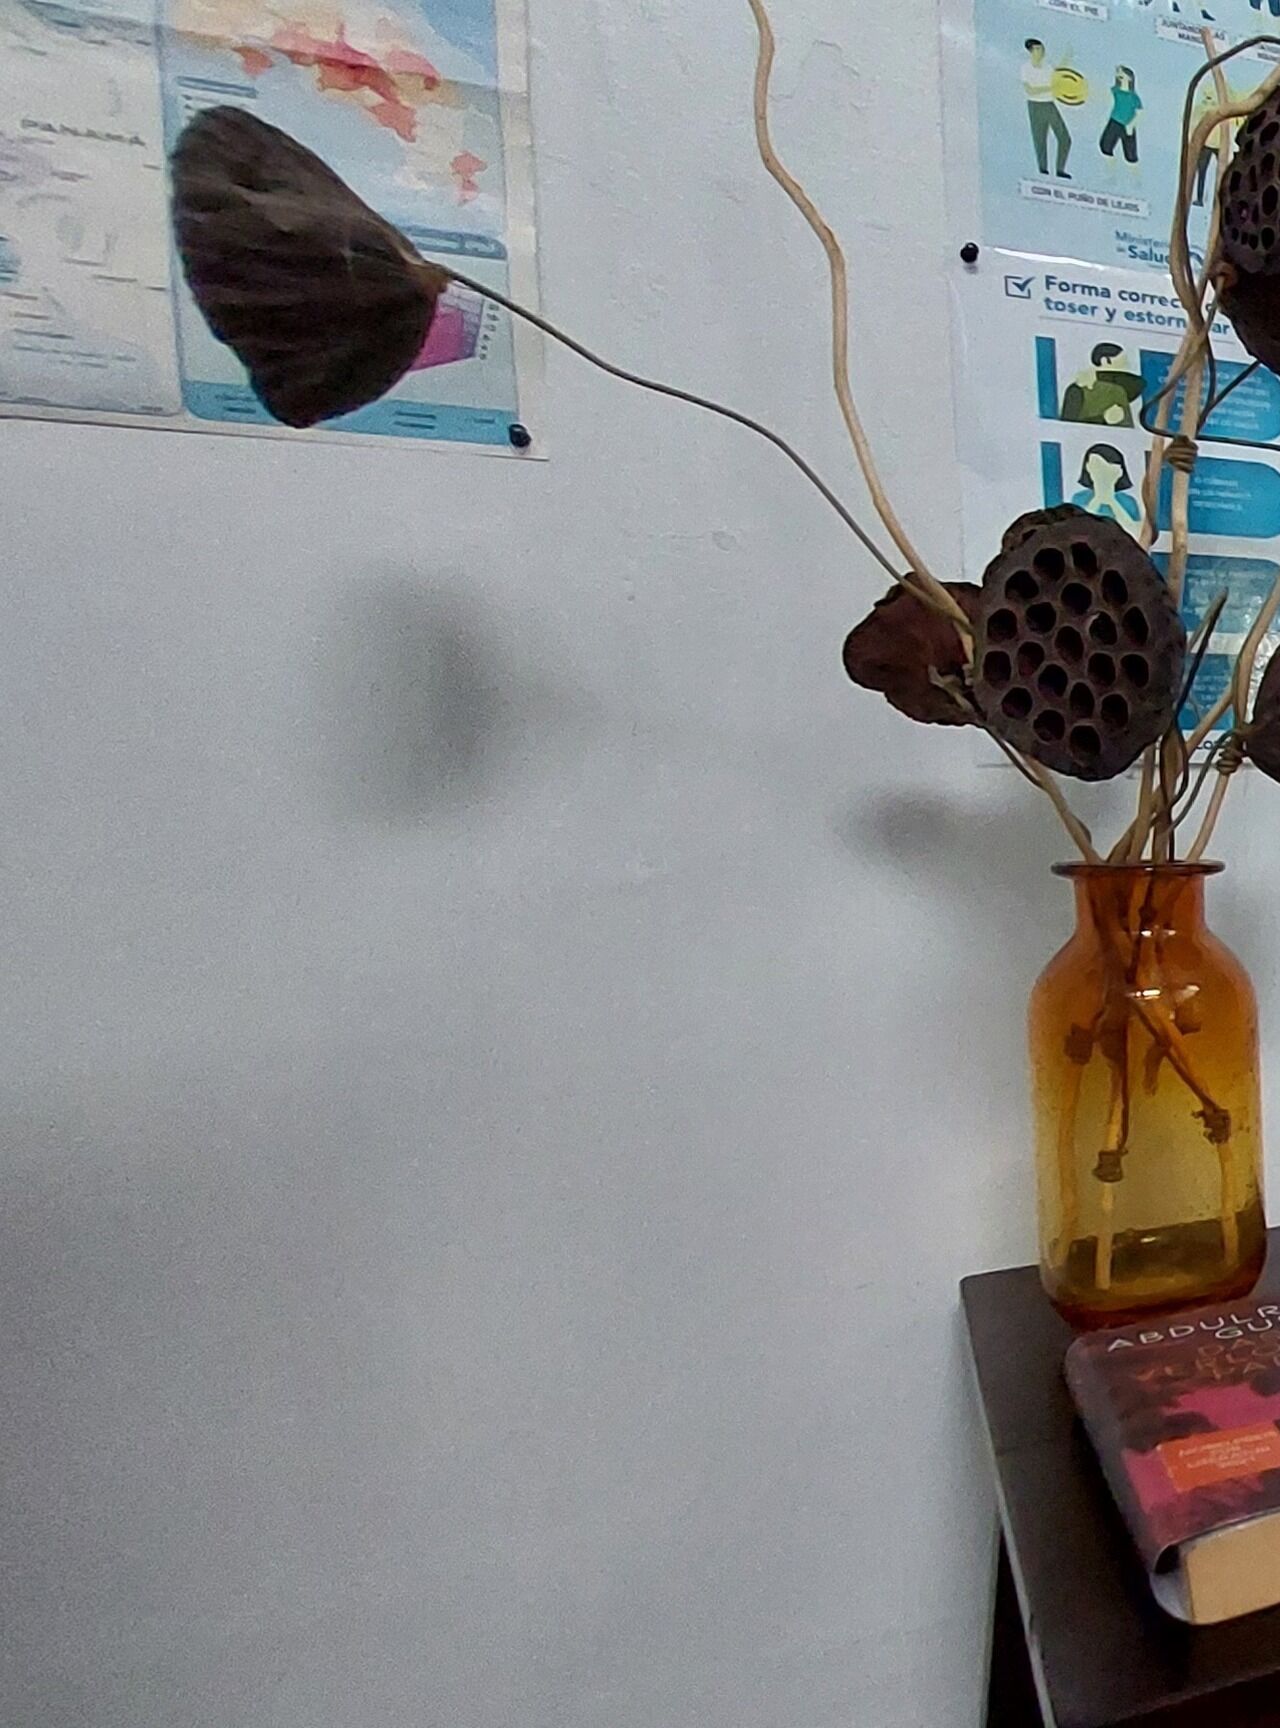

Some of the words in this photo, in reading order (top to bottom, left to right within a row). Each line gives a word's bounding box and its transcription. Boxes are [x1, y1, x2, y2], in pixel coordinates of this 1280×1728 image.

[1053, 188, 1065, 199] EL
[1128, 245, 1170, 264] Salu
[1045, 275, 1111, 299] Forma
[1118, 288, 1182, 309] correc
[1044, 297, 1098, 317] toser
[1105, 307, 1117, 322] y
[1124, 309, 1230, 335] estornar
